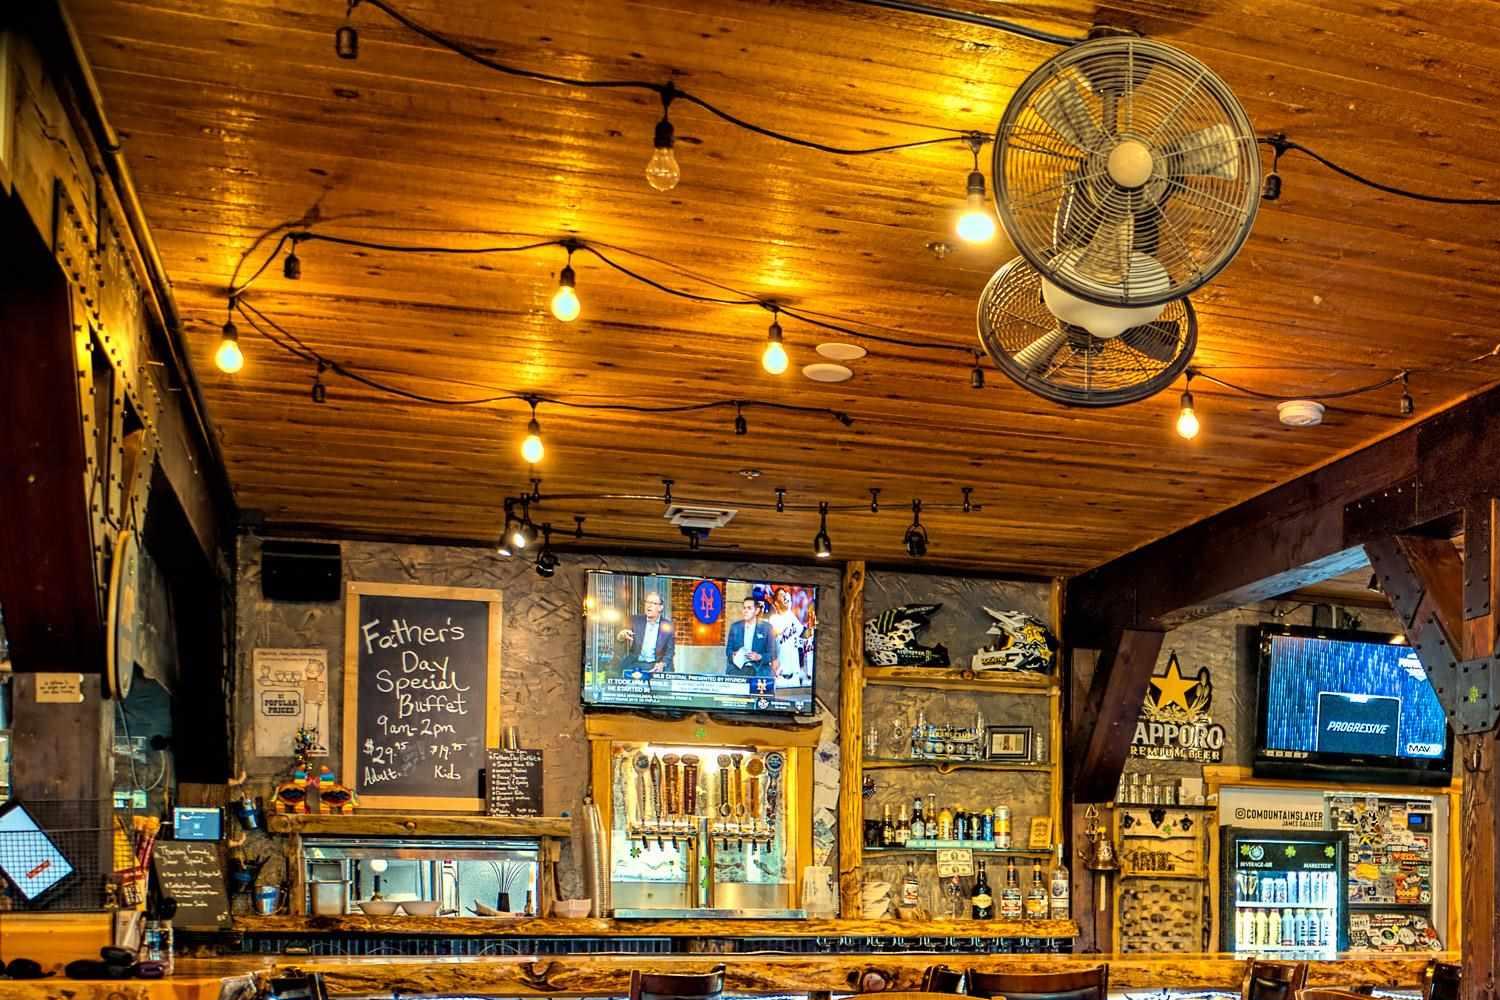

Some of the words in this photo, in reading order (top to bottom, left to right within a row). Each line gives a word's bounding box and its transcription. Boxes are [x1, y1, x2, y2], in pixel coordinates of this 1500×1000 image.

[362, 617, 464, 654] Father's
[402, 651, 449, 676] Day
[376, 669, 470, 699] Special
[399, 693, 468, 718] Buffet
[1132, 721, 1223, 750] APPORO
[1326, 721, 1391, 735] PROGRESSIVE
[1130, 746, 1185, 757] REMIUM
[1189, 750, 1220, 760] BEER
